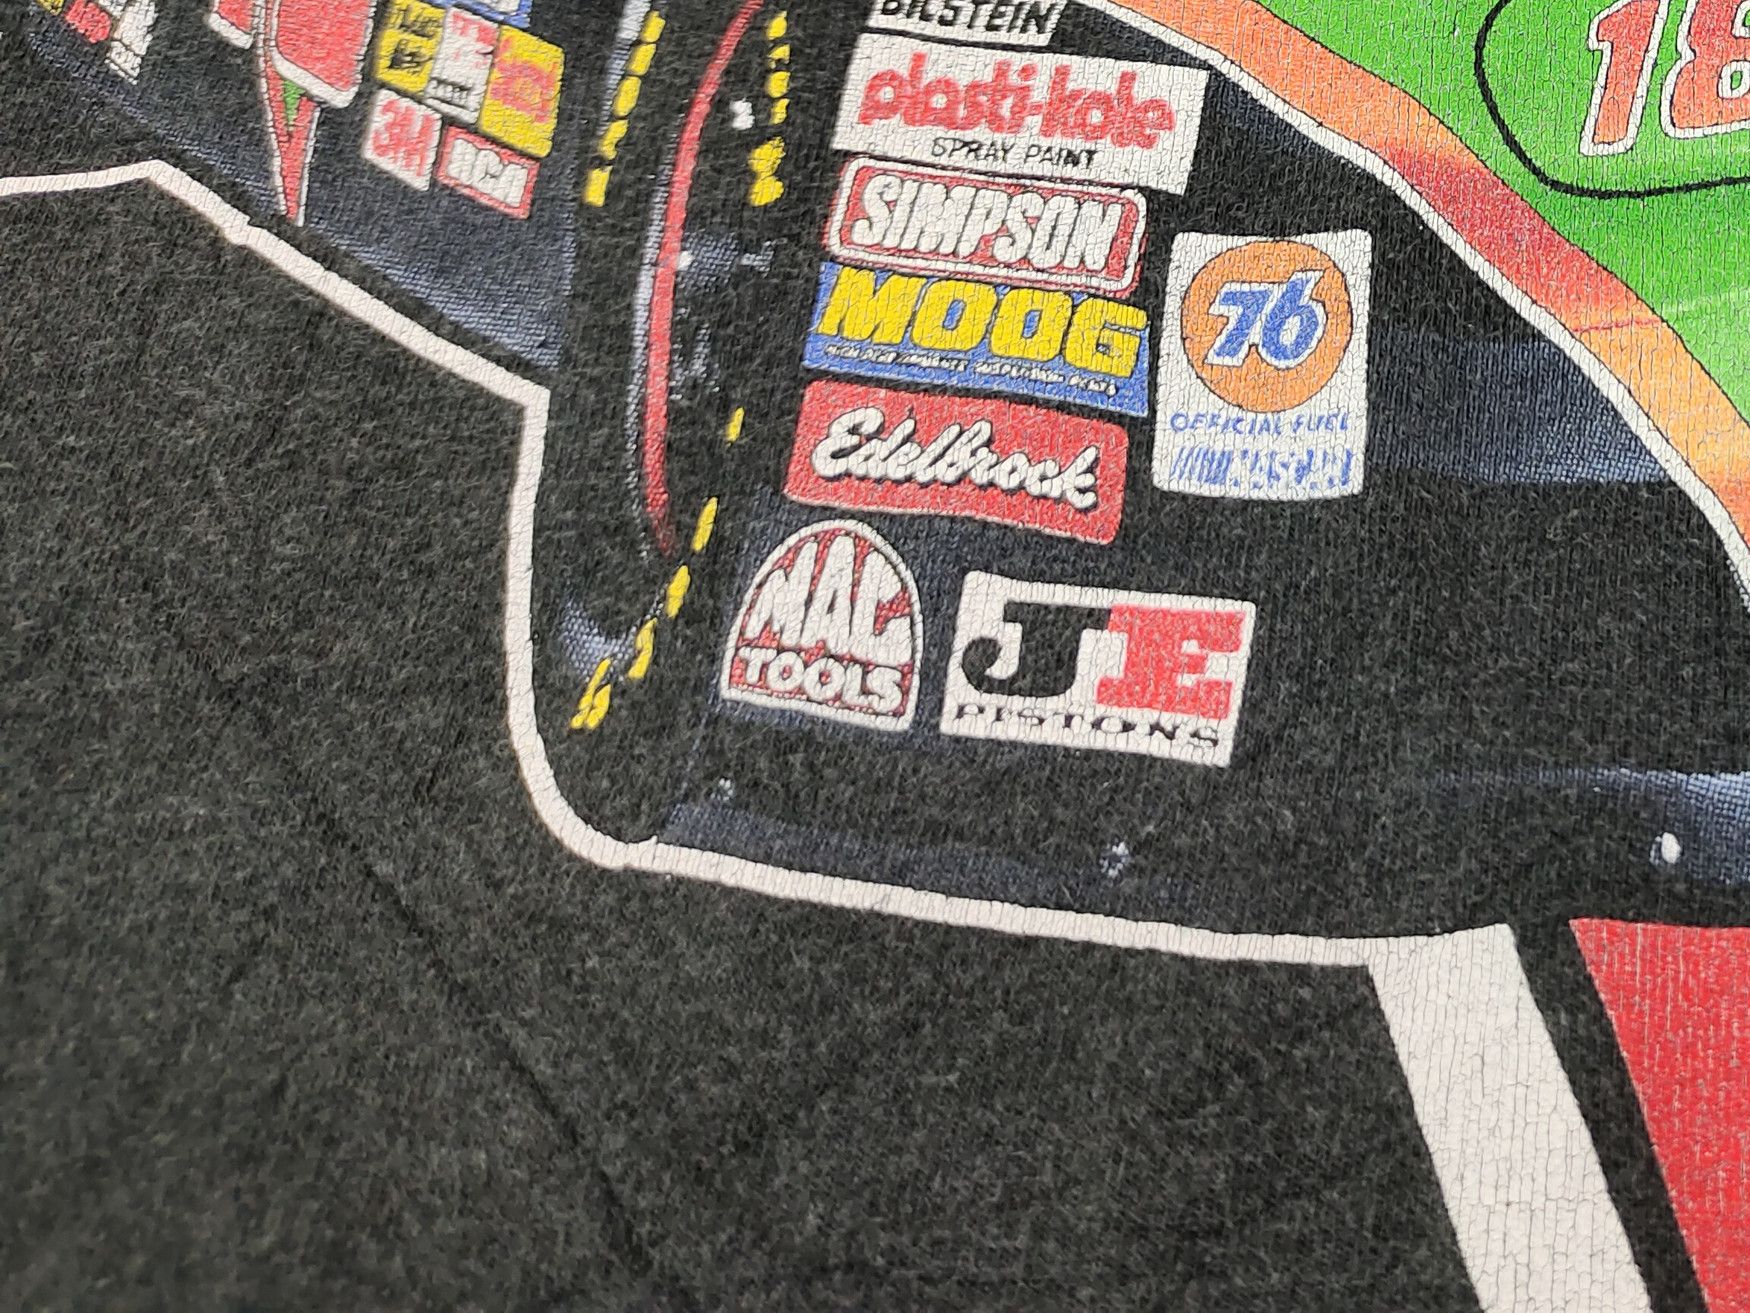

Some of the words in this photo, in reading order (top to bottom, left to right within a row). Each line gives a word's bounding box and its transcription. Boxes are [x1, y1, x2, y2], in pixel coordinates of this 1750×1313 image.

[931, 137, 1013, 166] SPRAY
[1022, 142, 1099, 168] PAINT
[850, 174, 1126, 272] SIMPSON
[817, 265, 1150, 378] MOOG
[1203, 269, 1328, 370] 76
[811, 406, 1100, 510] Edelbrock
[1170, 412, 1282, 436] OFFICIAL
[742, 534, 912, 667] MAC
[737, 646, 903, 713] TOOLS
[961, 599, 1248, 720] JE
[955, 702, 1221, 750] PISTONS
